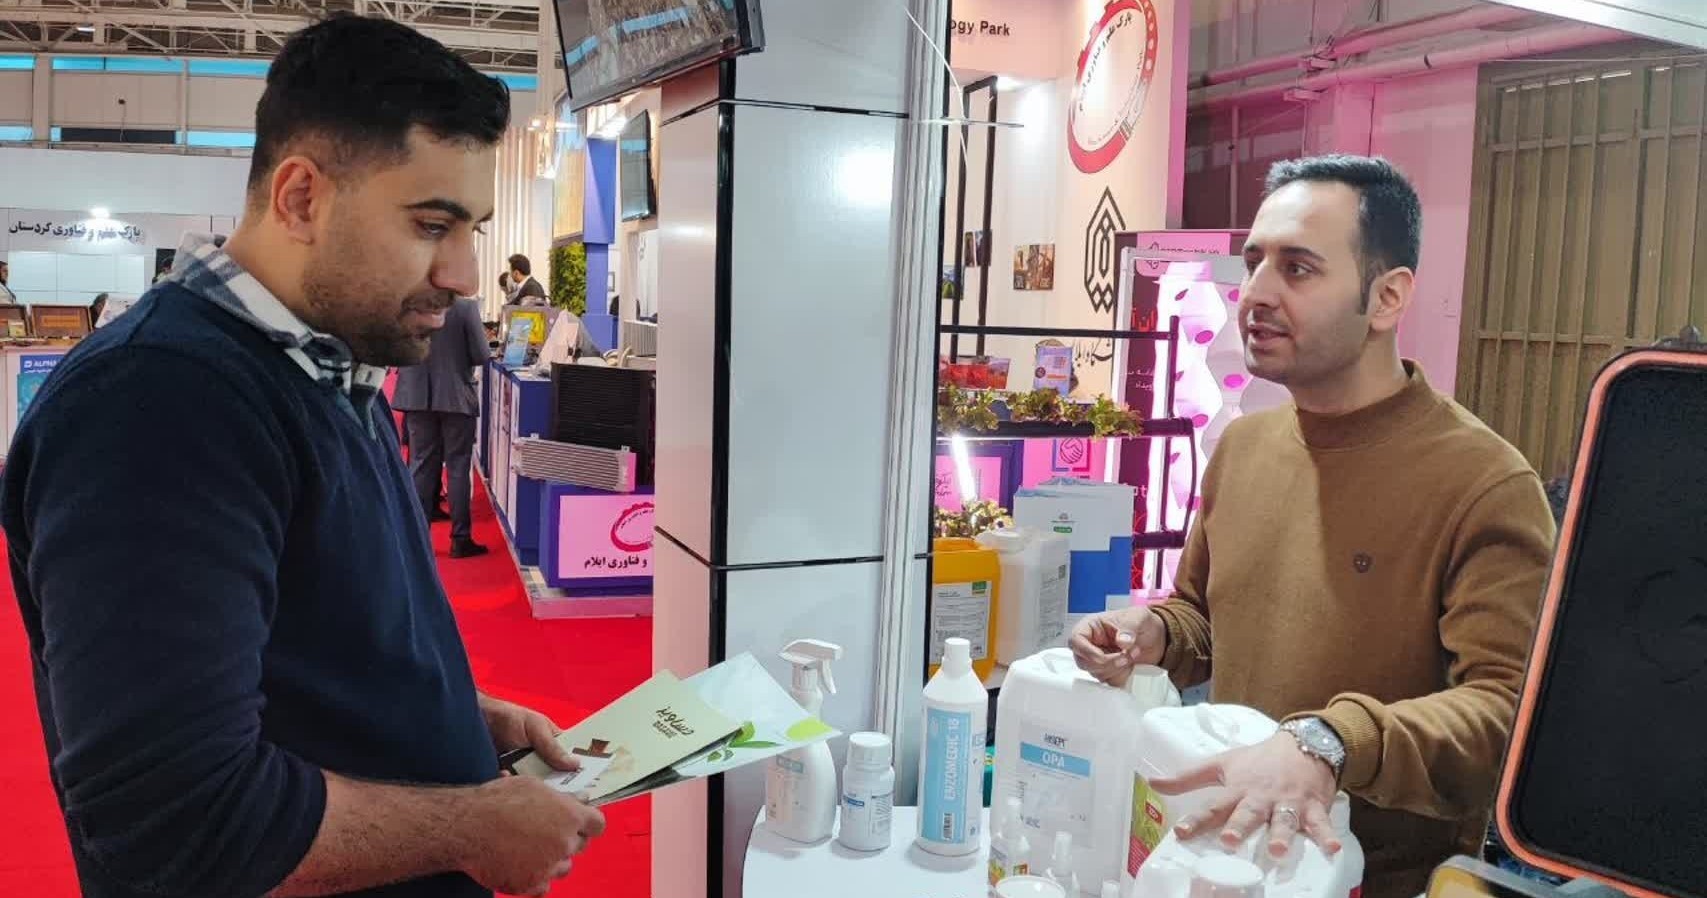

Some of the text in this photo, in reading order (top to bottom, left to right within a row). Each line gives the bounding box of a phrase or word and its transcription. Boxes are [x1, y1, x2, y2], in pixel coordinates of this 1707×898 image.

[980, 20, 1010, 36] Park
[9, 221, 52, 235] کردستان
[584, 554, 648, 570] و فناوری ایلام
[1041, 750, 1065, 769] OPA
